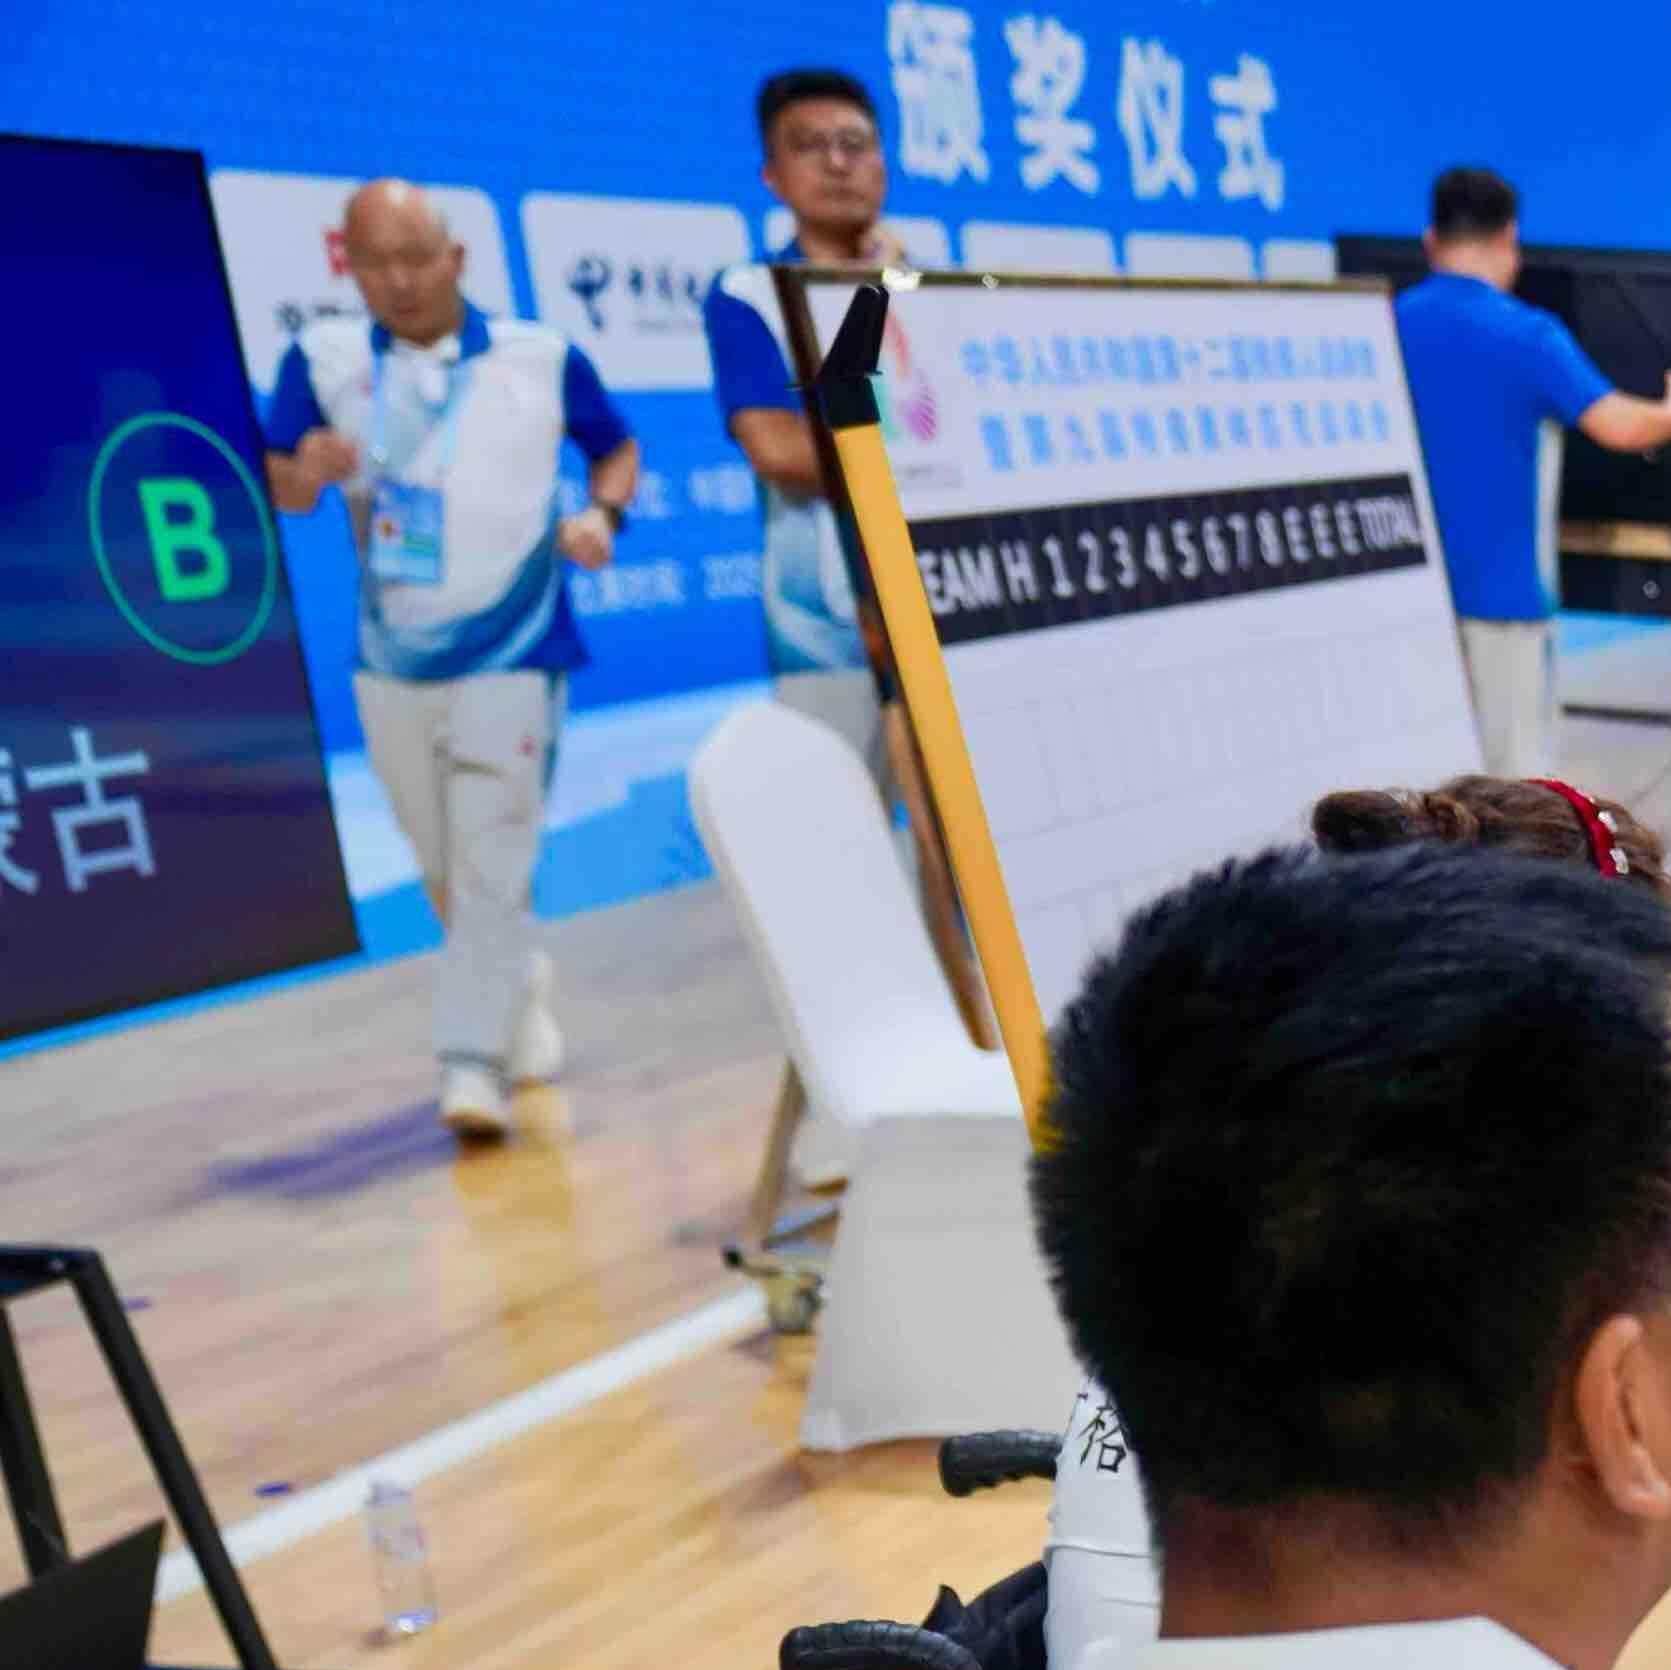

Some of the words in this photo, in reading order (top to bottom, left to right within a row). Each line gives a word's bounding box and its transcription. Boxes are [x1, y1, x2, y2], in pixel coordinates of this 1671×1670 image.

[887, 2, 1285, 213] 颁奖仪式
[137, 477, 231, 602] B
[916, 545, 1000, 614] EAM
[1000, 539, 1039, 603] H
[1042, 534, 1074, 597] 1
[1077, 529, 1108, 597] 2
[1110, 526, 1138, 588] 3
[1143, 522, 1169, 582] 4
[1172, 519, 1199, 579] 5
[1202, 516, 1230, 575] 6
[1229, 517, 1252, 571] 7
[1256, 511, 1285, 567] 8
[1283, 506, 1310, 562] E
[1310, 503, 1337, 559] E
[1335, 499, 1361, 556] E
